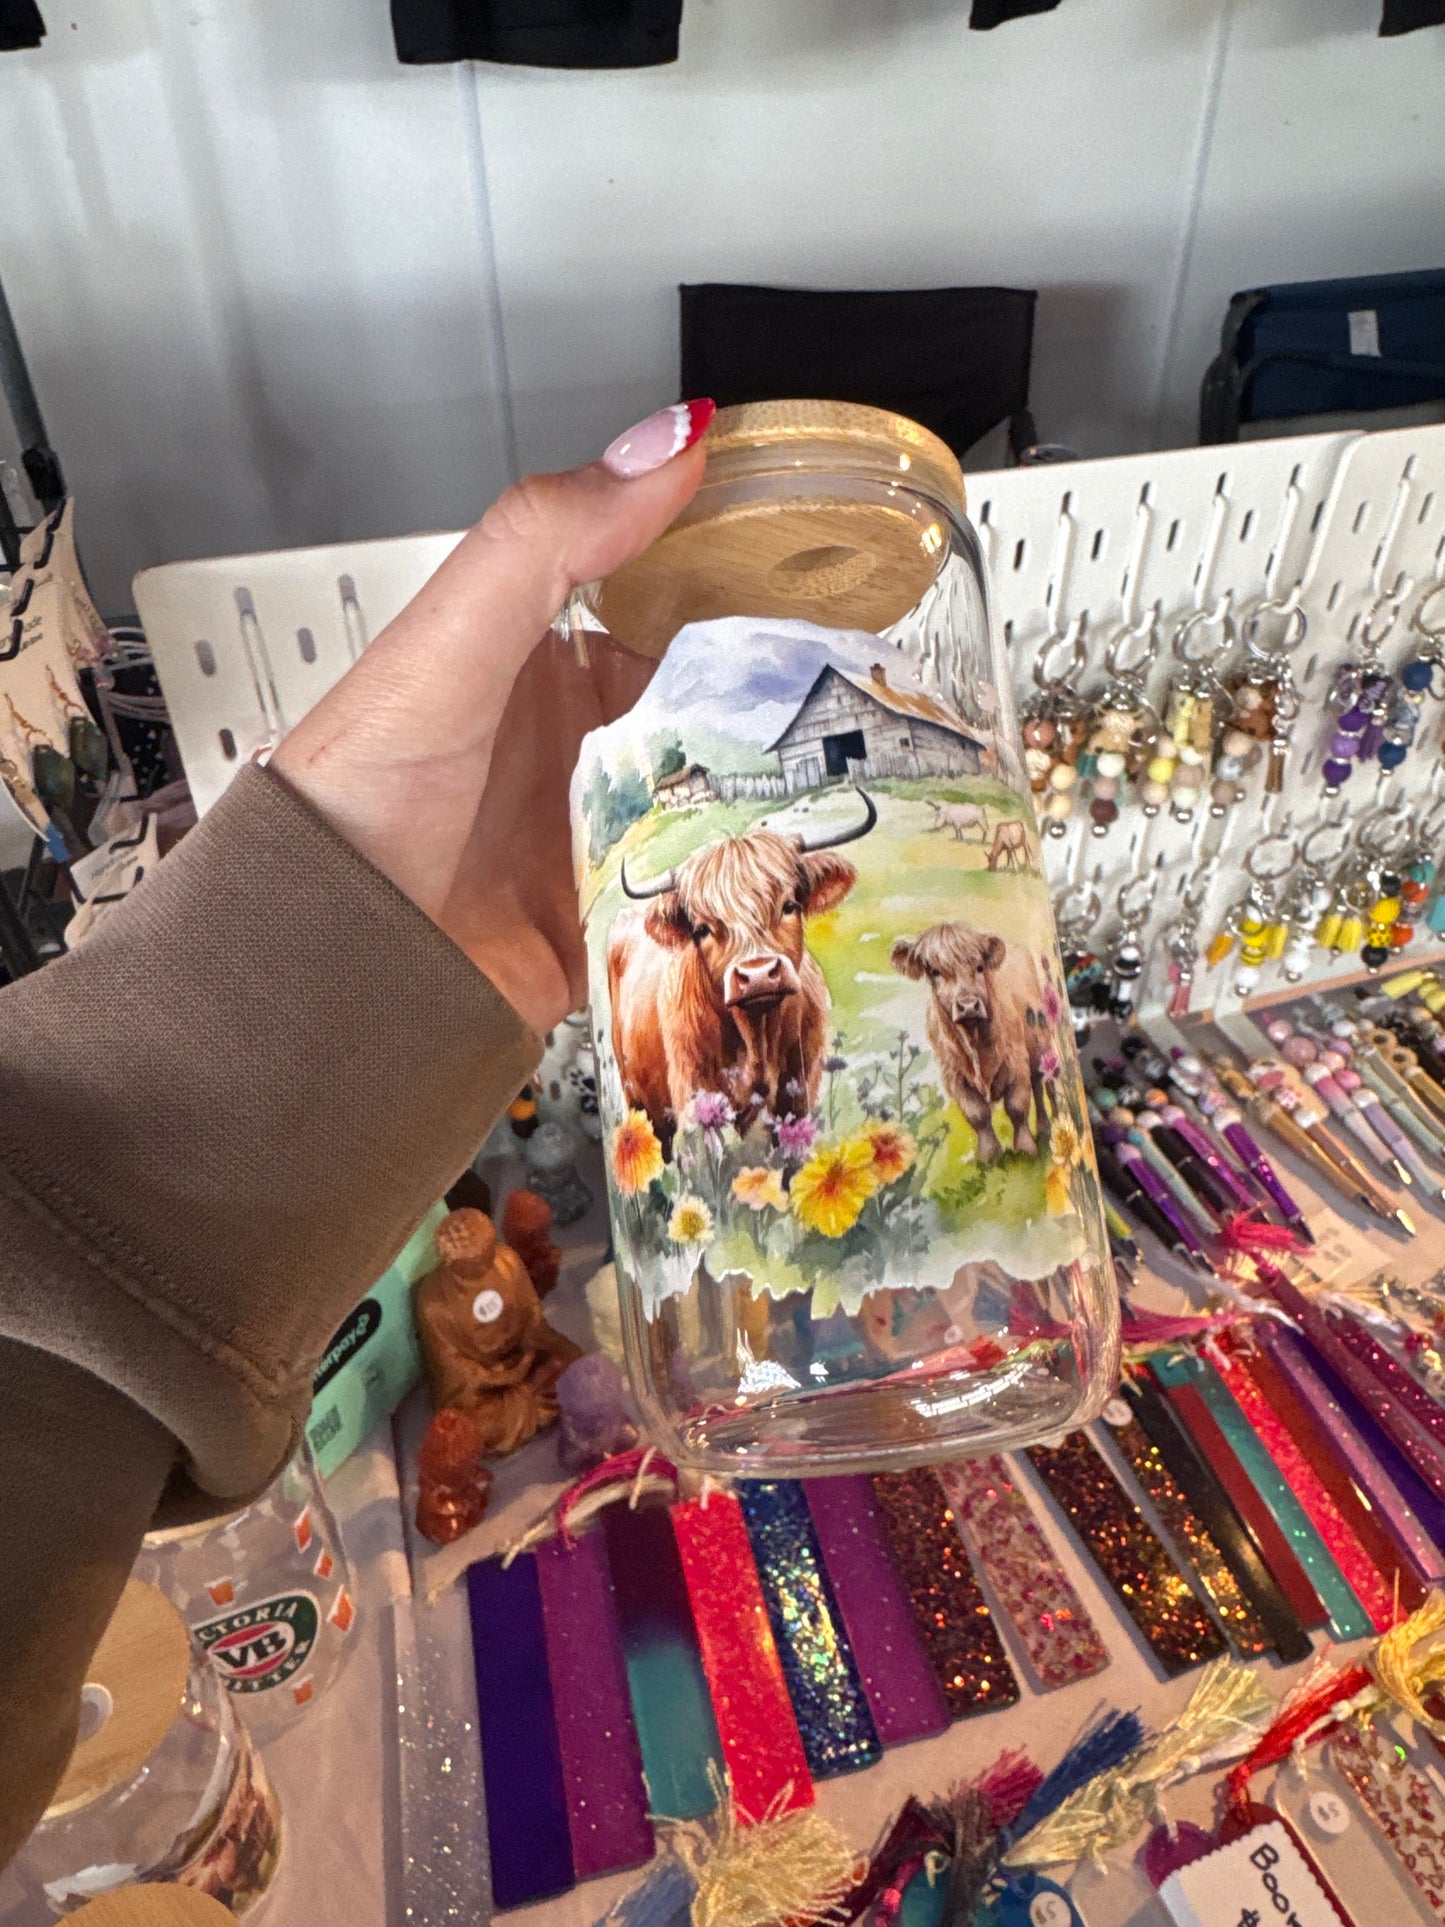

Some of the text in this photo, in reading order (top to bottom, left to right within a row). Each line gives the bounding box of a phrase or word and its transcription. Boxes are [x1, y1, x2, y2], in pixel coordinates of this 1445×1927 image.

[198, 1601, 299, 1641] CTORIA
[212, 1630, 287, 1669] VB
[224, 1639, 311, 1690] ITTER
